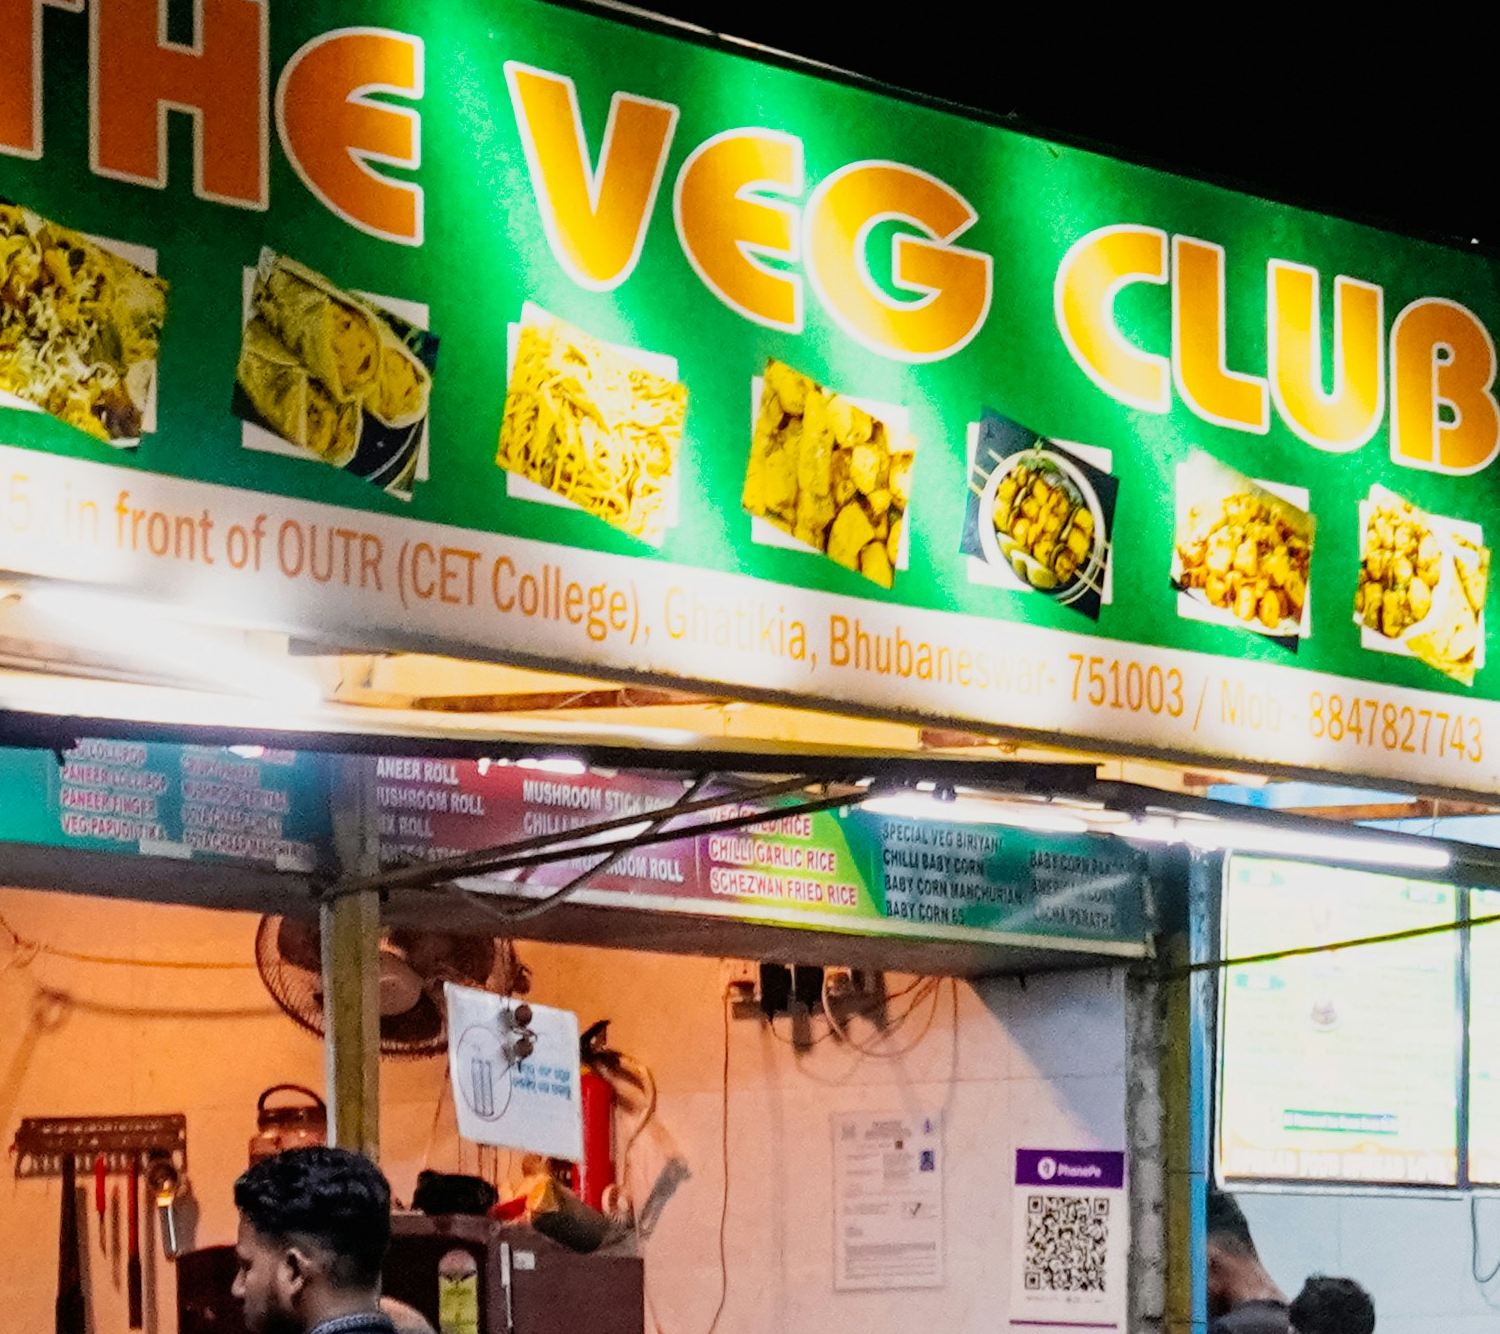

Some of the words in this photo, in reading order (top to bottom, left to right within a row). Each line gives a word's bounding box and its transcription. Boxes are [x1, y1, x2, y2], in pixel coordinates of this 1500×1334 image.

[502, 60, 993, 363] VEG
[62, 479, 100, 543] in
[114, 489, 214, 568] front
[226, 509, 268, 571] of
[276, 517, 384, 596] OUTR
[397, 535, 483, 612] (CET
[663, 585, 820, 674] Ghatikia,
[1068, 653, 1185, 721] 751003
[1219, 678, 1284, 732] Mob
[1308, 689, 1486, 765] 8847827743
[376, 756, 422, 782] ANEER
[424, 760, 460, 785] ROLL
[451, 793, 485, 816] ROLL
[523, 779, 602, 810] MUSHROOM
[604, 789, 641, 814] STICK
[781, 814, 812, 837] RICE
[882, 821, 929, 846] SPECIAL
[932, 828, 954, 848] VEG
[709, 837, 753, 863] CHILLI
[755, 843, 803, 868] GARLIC
[806, 850, 836, 872] RICE
[883, 848, 919, 869] CHILLI
[921, 853, 951, 874] BABY
[954, 857, 985, 877] CORN
[649, 858, 685, 883] ROLL
[710, 868, 784, 898] SCHEZWAN
[787, 880, 824, 903] FRIED
[827, 884, 858, 907] RICE
[884, 874, 914, 894] BABY
[916, 876, 948, 898] CORN
[886, 899, 916, 920] BABY
[918, 903, 950, 925] CORN
